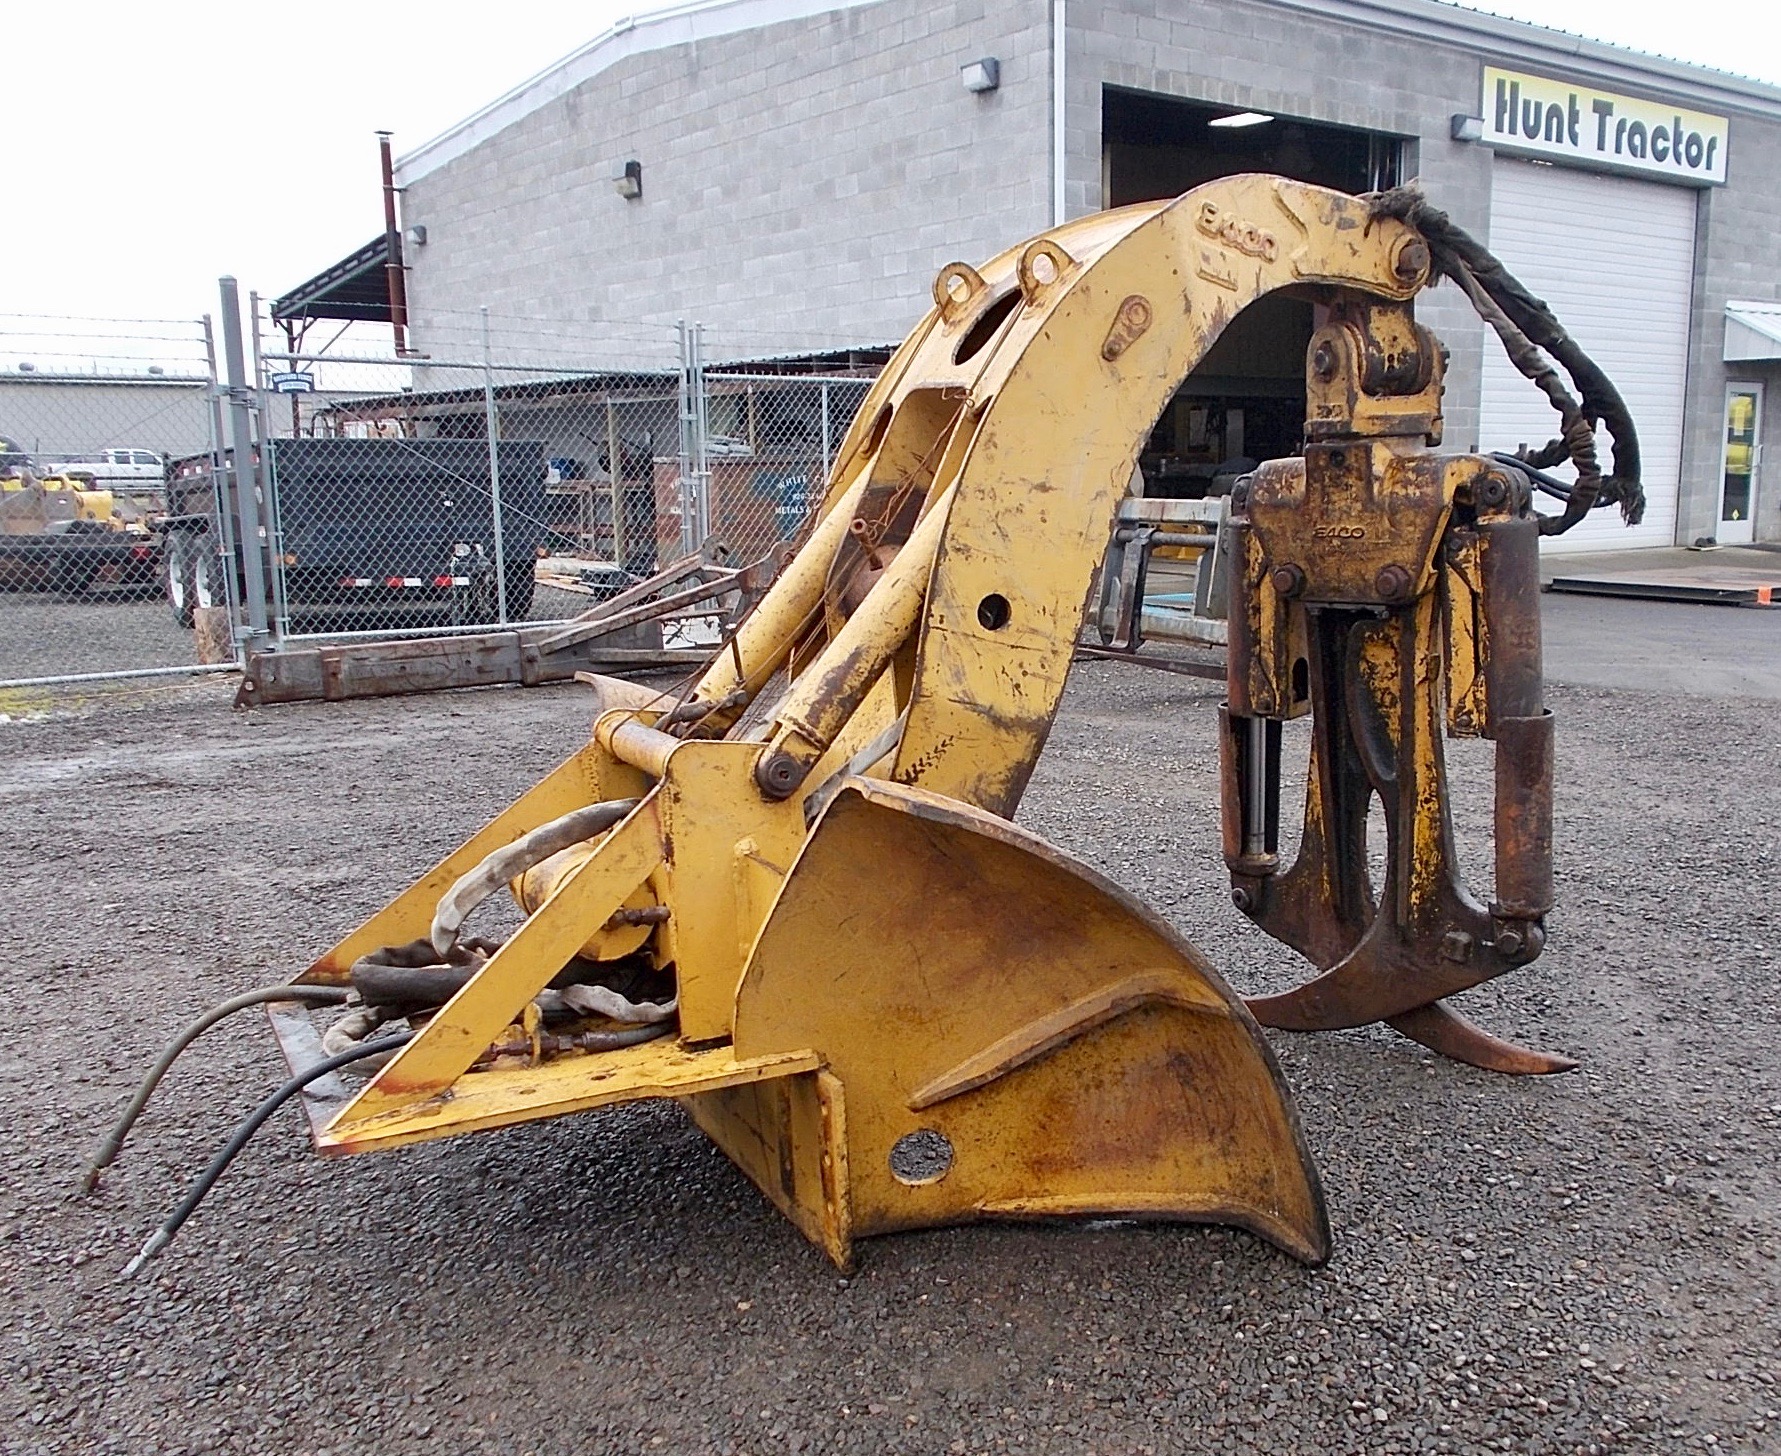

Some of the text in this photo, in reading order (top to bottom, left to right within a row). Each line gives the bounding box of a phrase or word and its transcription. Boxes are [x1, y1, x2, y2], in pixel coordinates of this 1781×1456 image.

[1495, 77, 1718, 171] Hunt Tractor
[778, 474, 807, 489] WHITE
[775, 506, 804, 514] METALS
